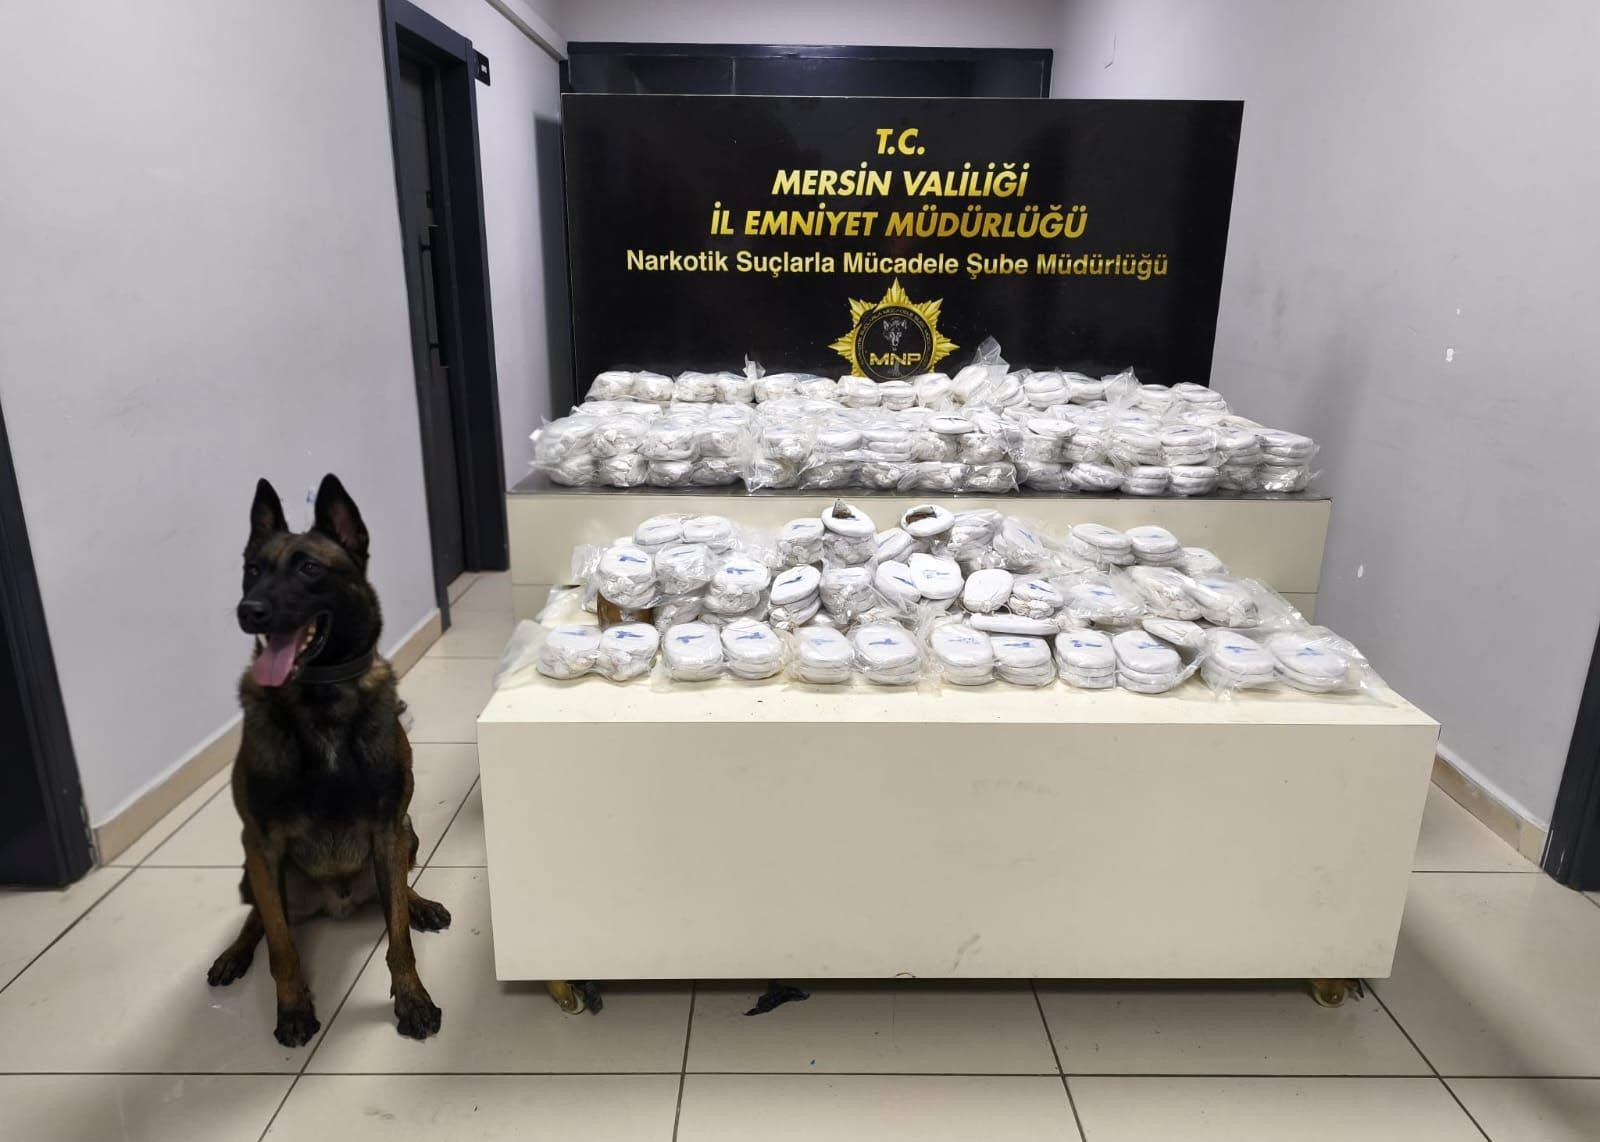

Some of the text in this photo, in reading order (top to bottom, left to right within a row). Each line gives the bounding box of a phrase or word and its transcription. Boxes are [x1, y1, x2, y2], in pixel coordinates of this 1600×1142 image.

[876, 128, 925, 155] T.C.
[772, 162, 1030, 198] MERSİN VALİLİĞİ
[711, 201, 1088, 239] İL EMNİYET MÜDÜRLÜĞÜ
[626, 249, 1167, 280] Narkotik Suçlarla Mücadele Şube Müdürlüğü
[870, 353, 921, 365] MNP
